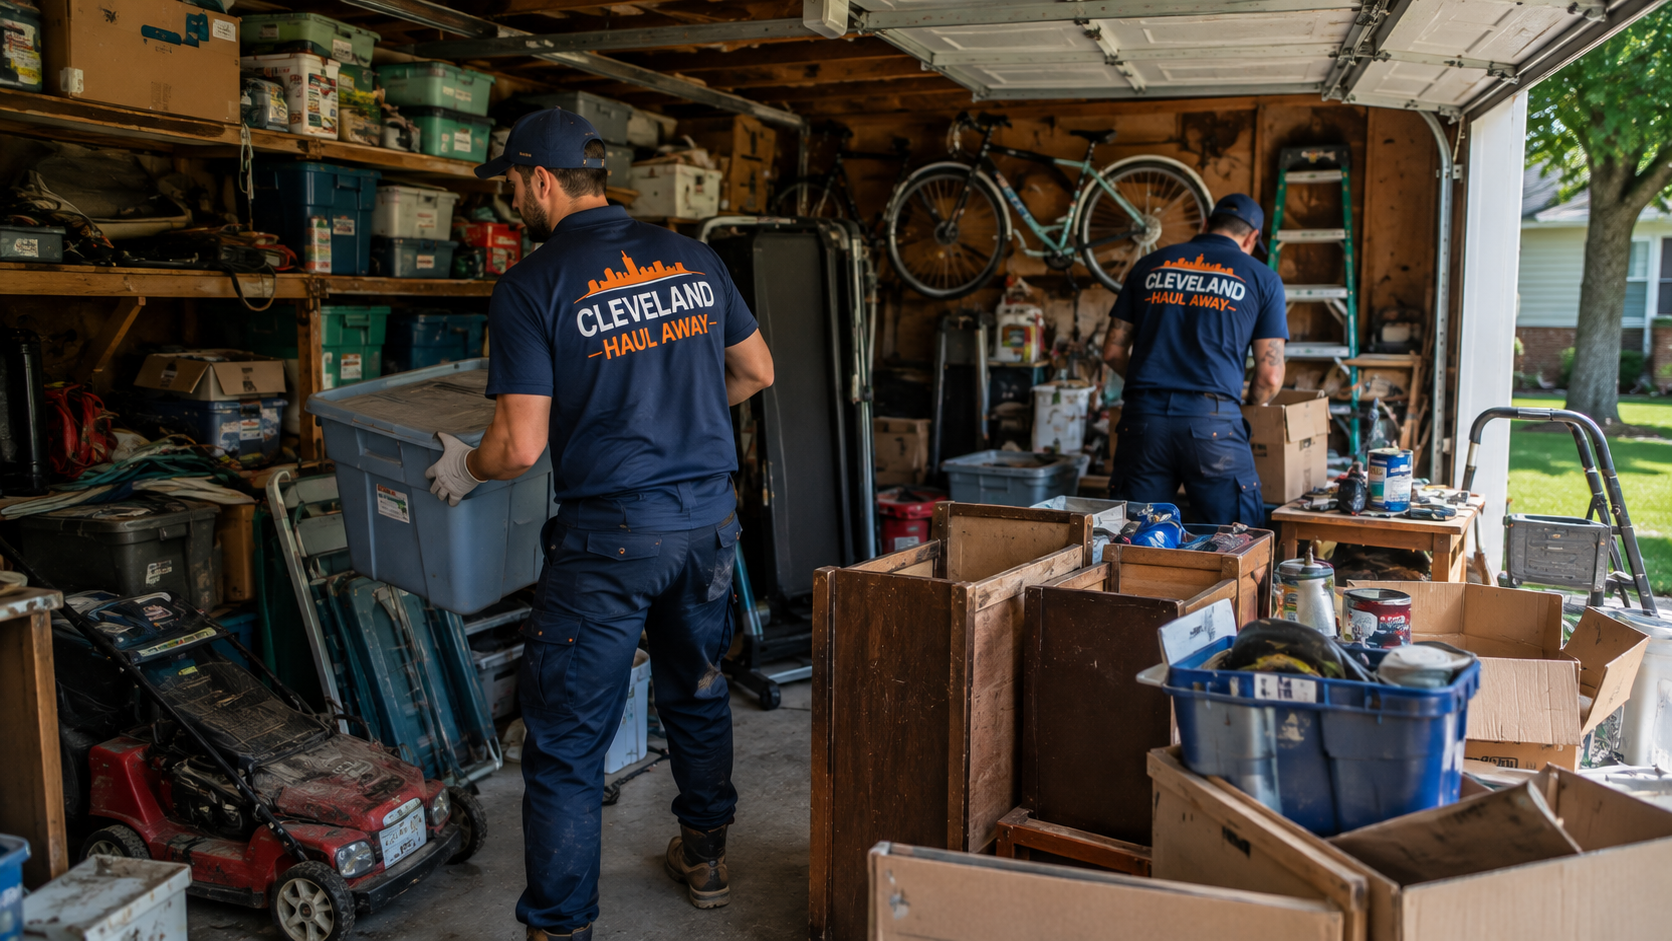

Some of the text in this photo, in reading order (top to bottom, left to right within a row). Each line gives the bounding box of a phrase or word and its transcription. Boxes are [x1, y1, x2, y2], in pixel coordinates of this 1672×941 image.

[1145, 272, 1246, 301] CLEVELAND
[1151, 291, 1230, 312] HAUL AWAY
[576, 281, 715, 338] CLEVELAND
[603, 314, 709, 360] HAUL AWAY
